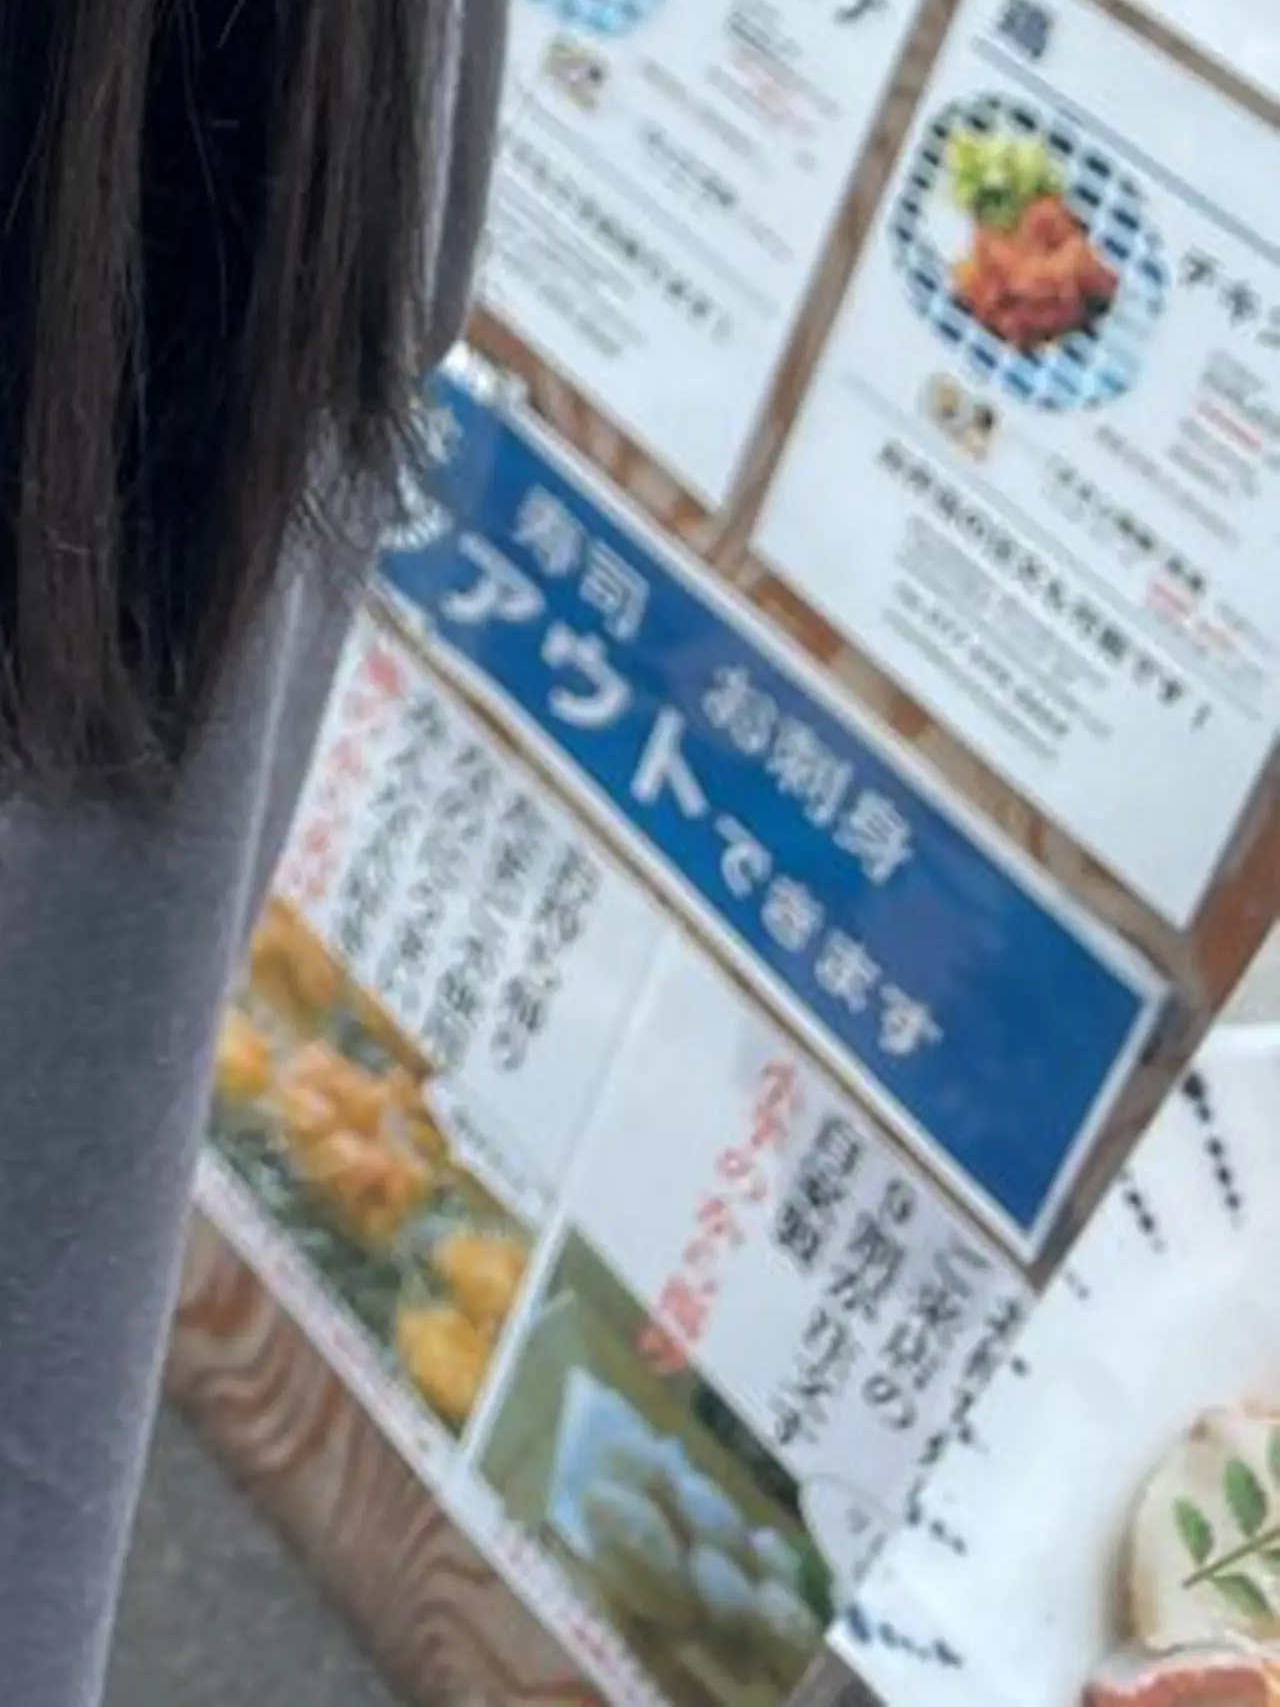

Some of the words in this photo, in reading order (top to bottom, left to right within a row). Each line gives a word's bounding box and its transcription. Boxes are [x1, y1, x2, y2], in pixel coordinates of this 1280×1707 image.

[512, 484, 650, 645] 寿司
[699, 663, 917, 885] お刺身
